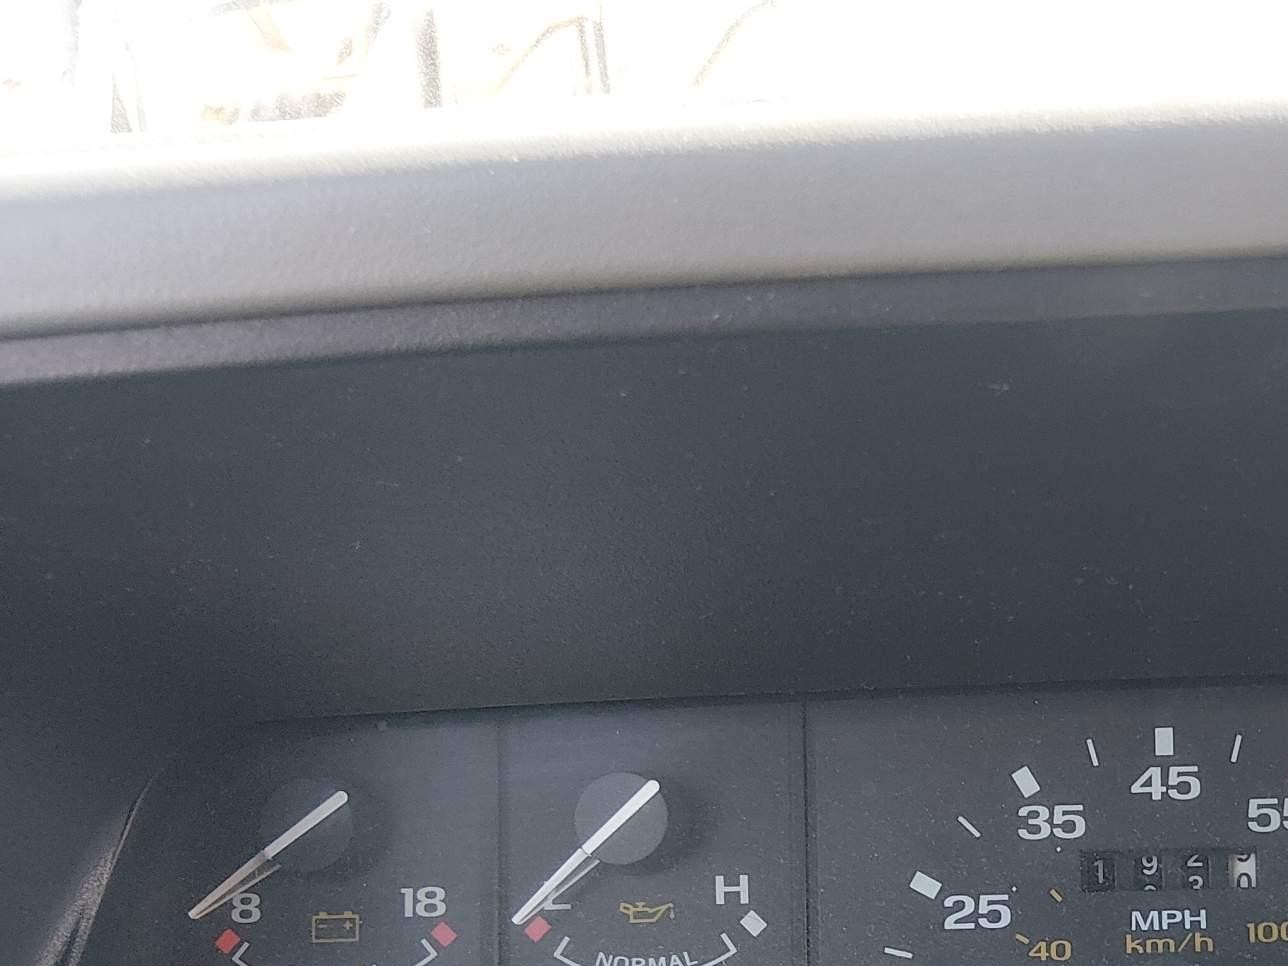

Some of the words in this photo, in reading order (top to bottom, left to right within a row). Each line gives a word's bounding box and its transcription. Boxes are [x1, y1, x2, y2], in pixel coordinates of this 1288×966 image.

[1131, 766, 1200, 800] 45
[1018, 805, 1085, 839] 35
[401, 887, 445, 917] 18
[716, 875, 748, 904] H
[231, 893, 261, 924] 8
[944, 895, 1010, 929] 25
[1132, 910, 1206, 930] MPH
[1029, 941, 1071, 960] 40
[1126, 933, 1214, 954] km/h
